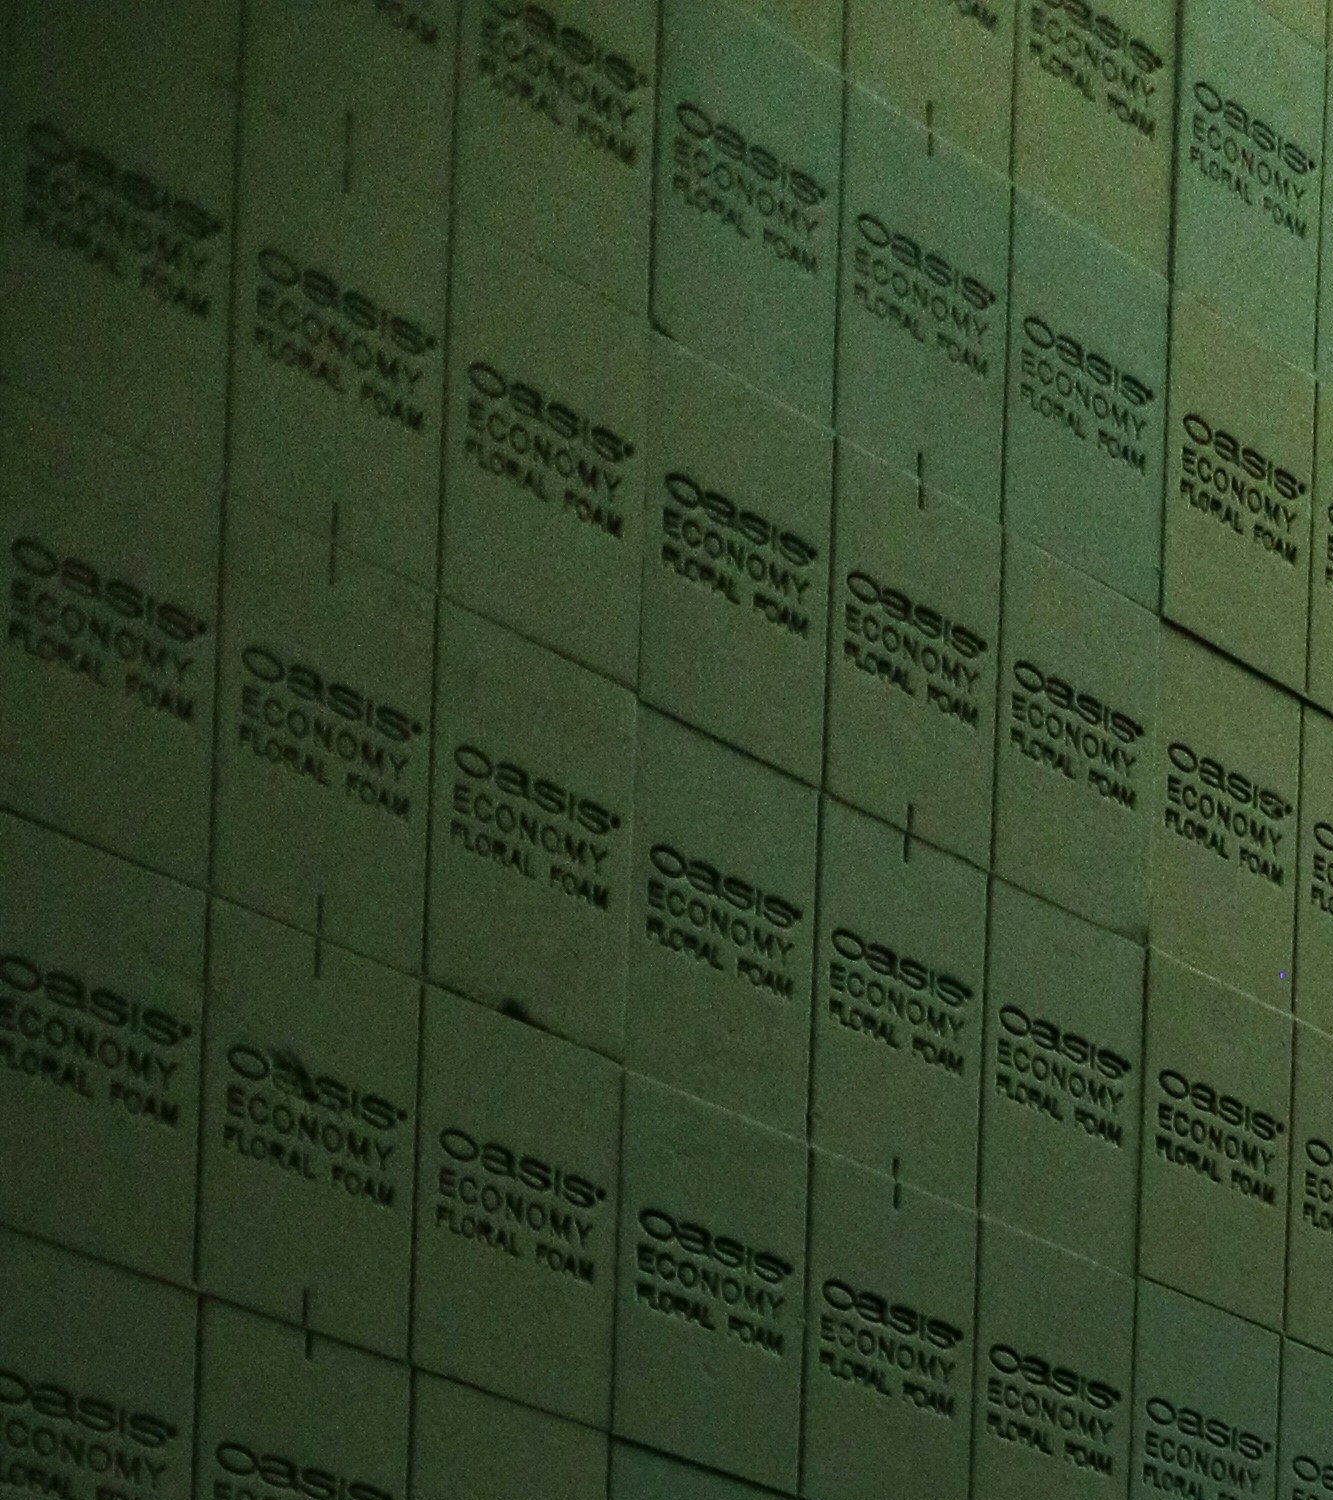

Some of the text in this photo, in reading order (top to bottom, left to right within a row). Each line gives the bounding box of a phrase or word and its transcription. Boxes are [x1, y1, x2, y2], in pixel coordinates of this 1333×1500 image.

[253, 327, 425, 436] FLORAL FOAM
[257, 287, 423, 395] ECONOMY
[1180, 479, 1298, 567] FLORAL FOAM
[1183, 446, 1297, 533] ECONOMY
[828, 998, 966, 1077] FLORAL FOAM
[831, 964, 965, 1042] ECONOMY
[986, 1412, 1115, 1476] FLORAL FOAM
[989, 1378, 1113, 1444] ECONOMY
